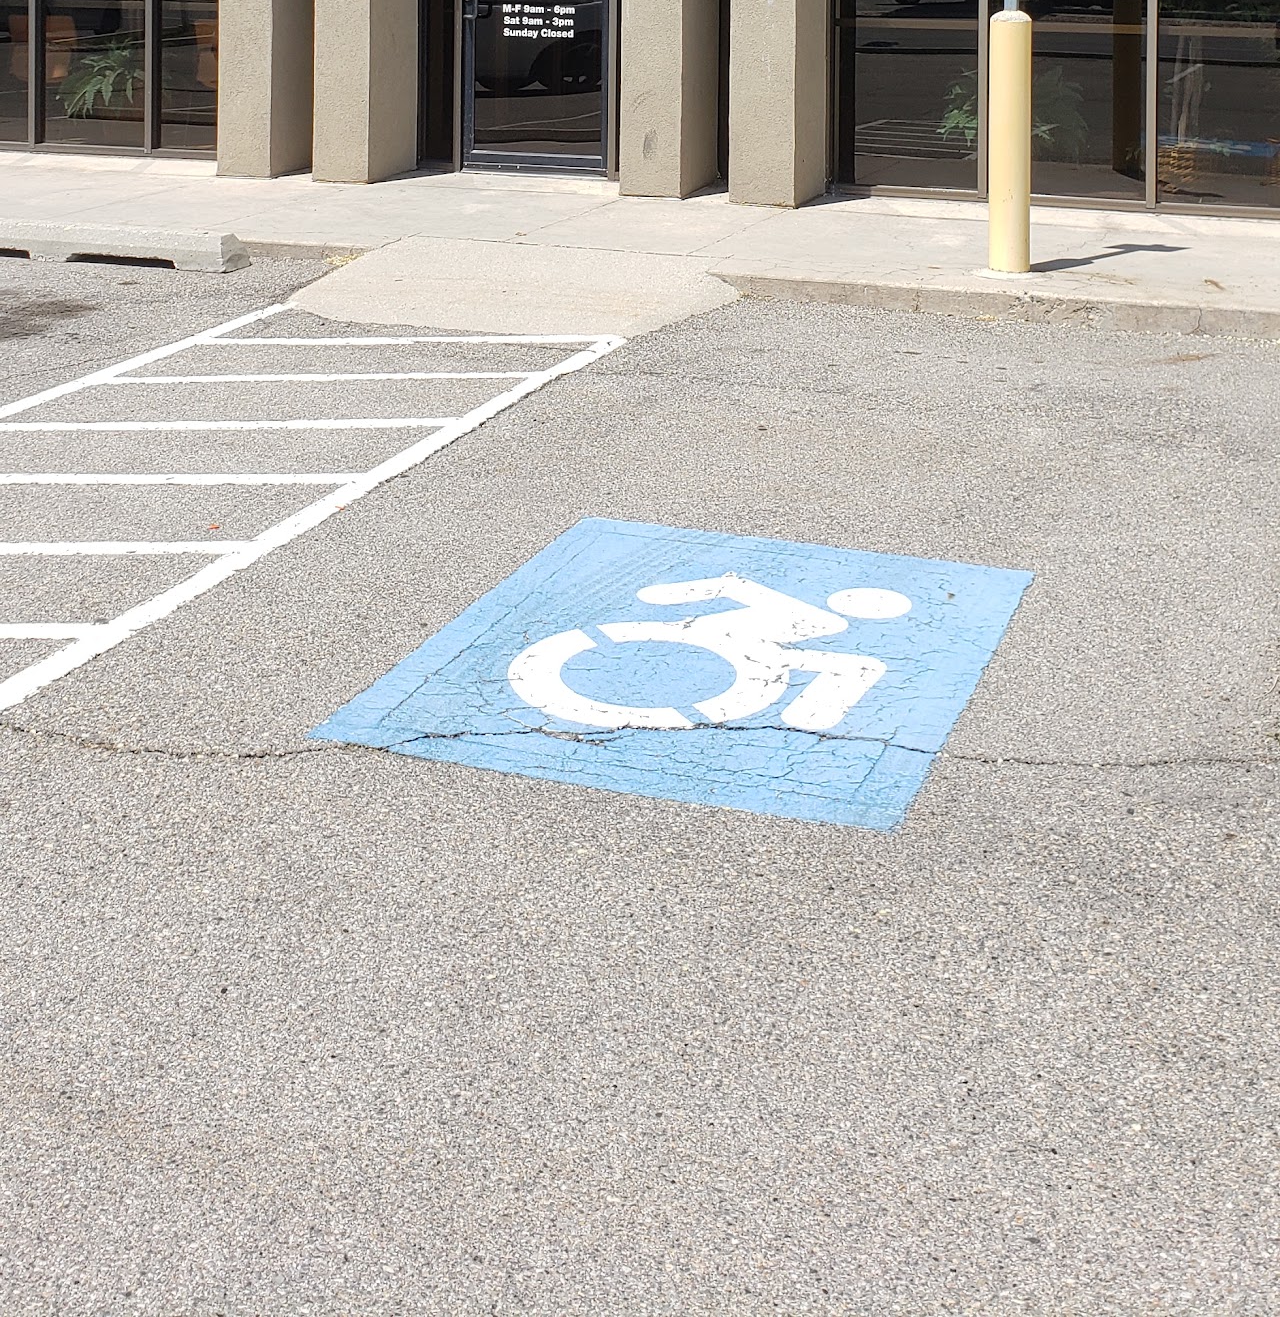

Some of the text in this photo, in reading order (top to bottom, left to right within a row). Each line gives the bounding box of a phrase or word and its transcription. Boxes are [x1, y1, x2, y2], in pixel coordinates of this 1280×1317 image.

[502, 4, 521, 13] M-F
[523, 5, 544, 13] 9am
[553, 5, 576, 15] 6pm
[503, 16, 520, 25] Sat
[522, 16, 543, 25] 9am
[552, 17, 574, 27] 3pm
[503, 28, 575, 39] Sunday Closed
